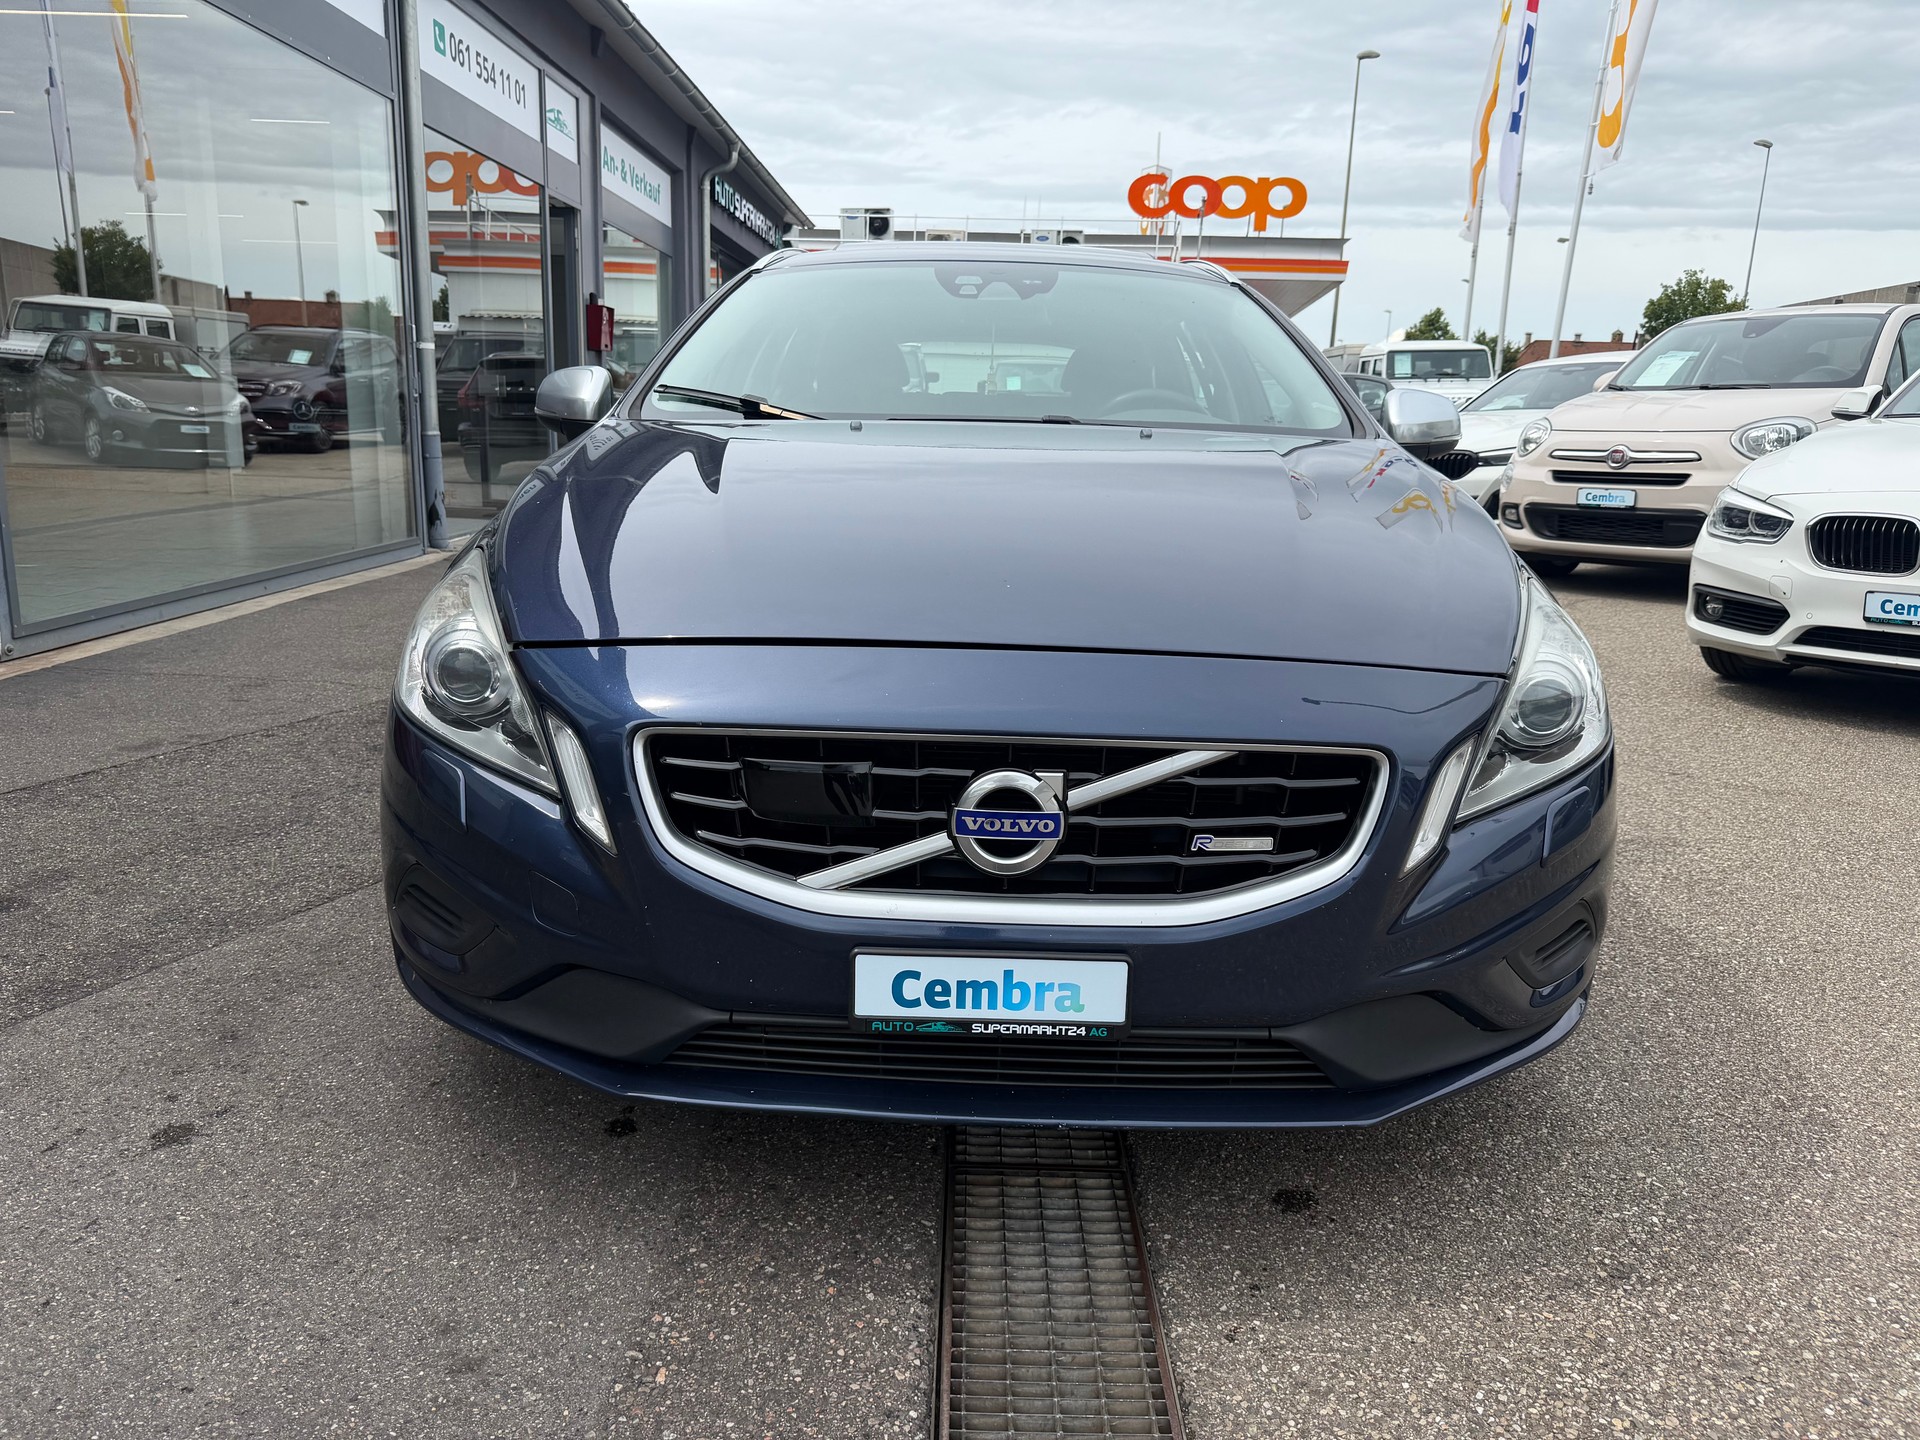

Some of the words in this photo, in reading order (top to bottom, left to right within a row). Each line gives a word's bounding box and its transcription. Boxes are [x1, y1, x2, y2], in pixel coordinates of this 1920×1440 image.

[449, 32, 471, 73] 061
[475, 50, 497, 89] 554
[499, 69, 511, 99] 11
[514, 79, 527, 109] 01
[602, 145, 619, 176] An-
[620, 158, 628, 184] &
[628, 163, 661, 205] Verkauf
[1585, 492, 1626, 503] Cembra
[961, 816, 1055, 833] VOLVO
[891, 969, 1085, 1013] Cembra
[871, 1021, 914, 1032] AUTO
[971, 1023, 1086, 1037] SUPERMARKT24
[1089, 1027, 1107, 1037] AG
